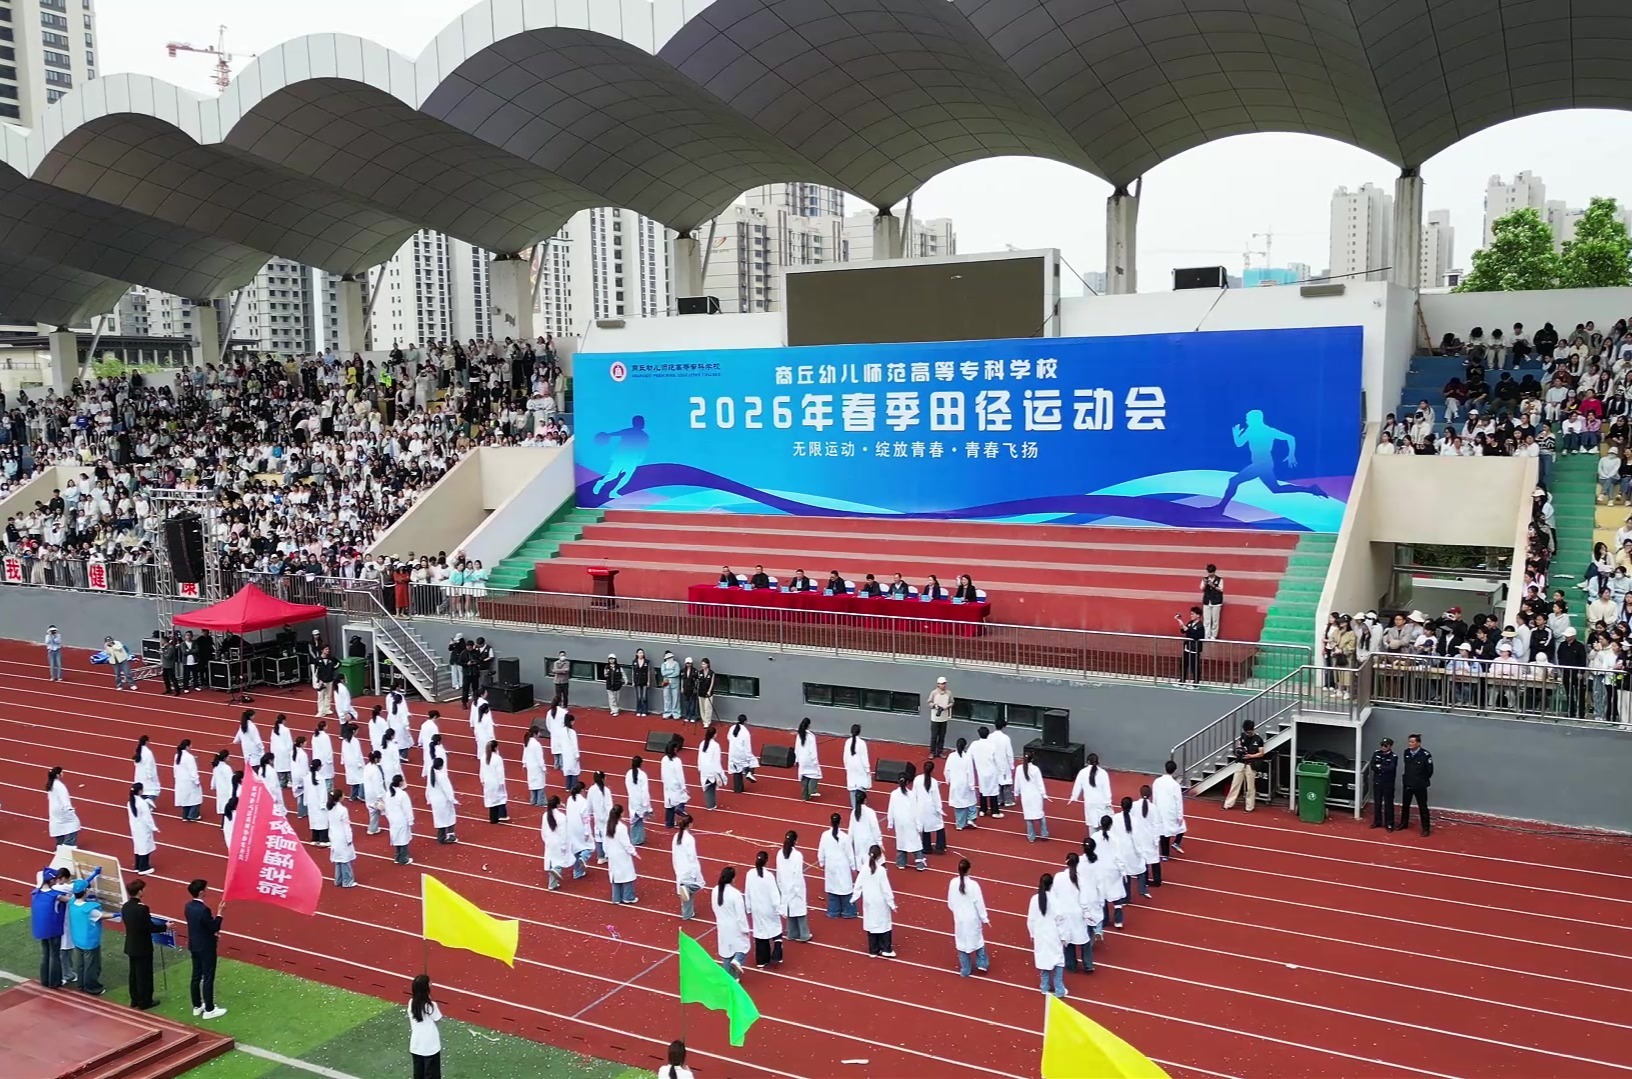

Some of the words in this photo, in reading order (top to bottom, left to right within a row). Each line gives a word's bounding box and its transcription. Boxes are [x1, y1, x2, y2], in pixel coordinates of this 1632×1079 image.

[774, 358, 1058, 385] 商丘幼儿师范高等专科学校
[689, 386, 1167, 432] 2026年春季田径运动会
[5, 558, 21, 581] 我
[89, 564, 106, 589] 健
